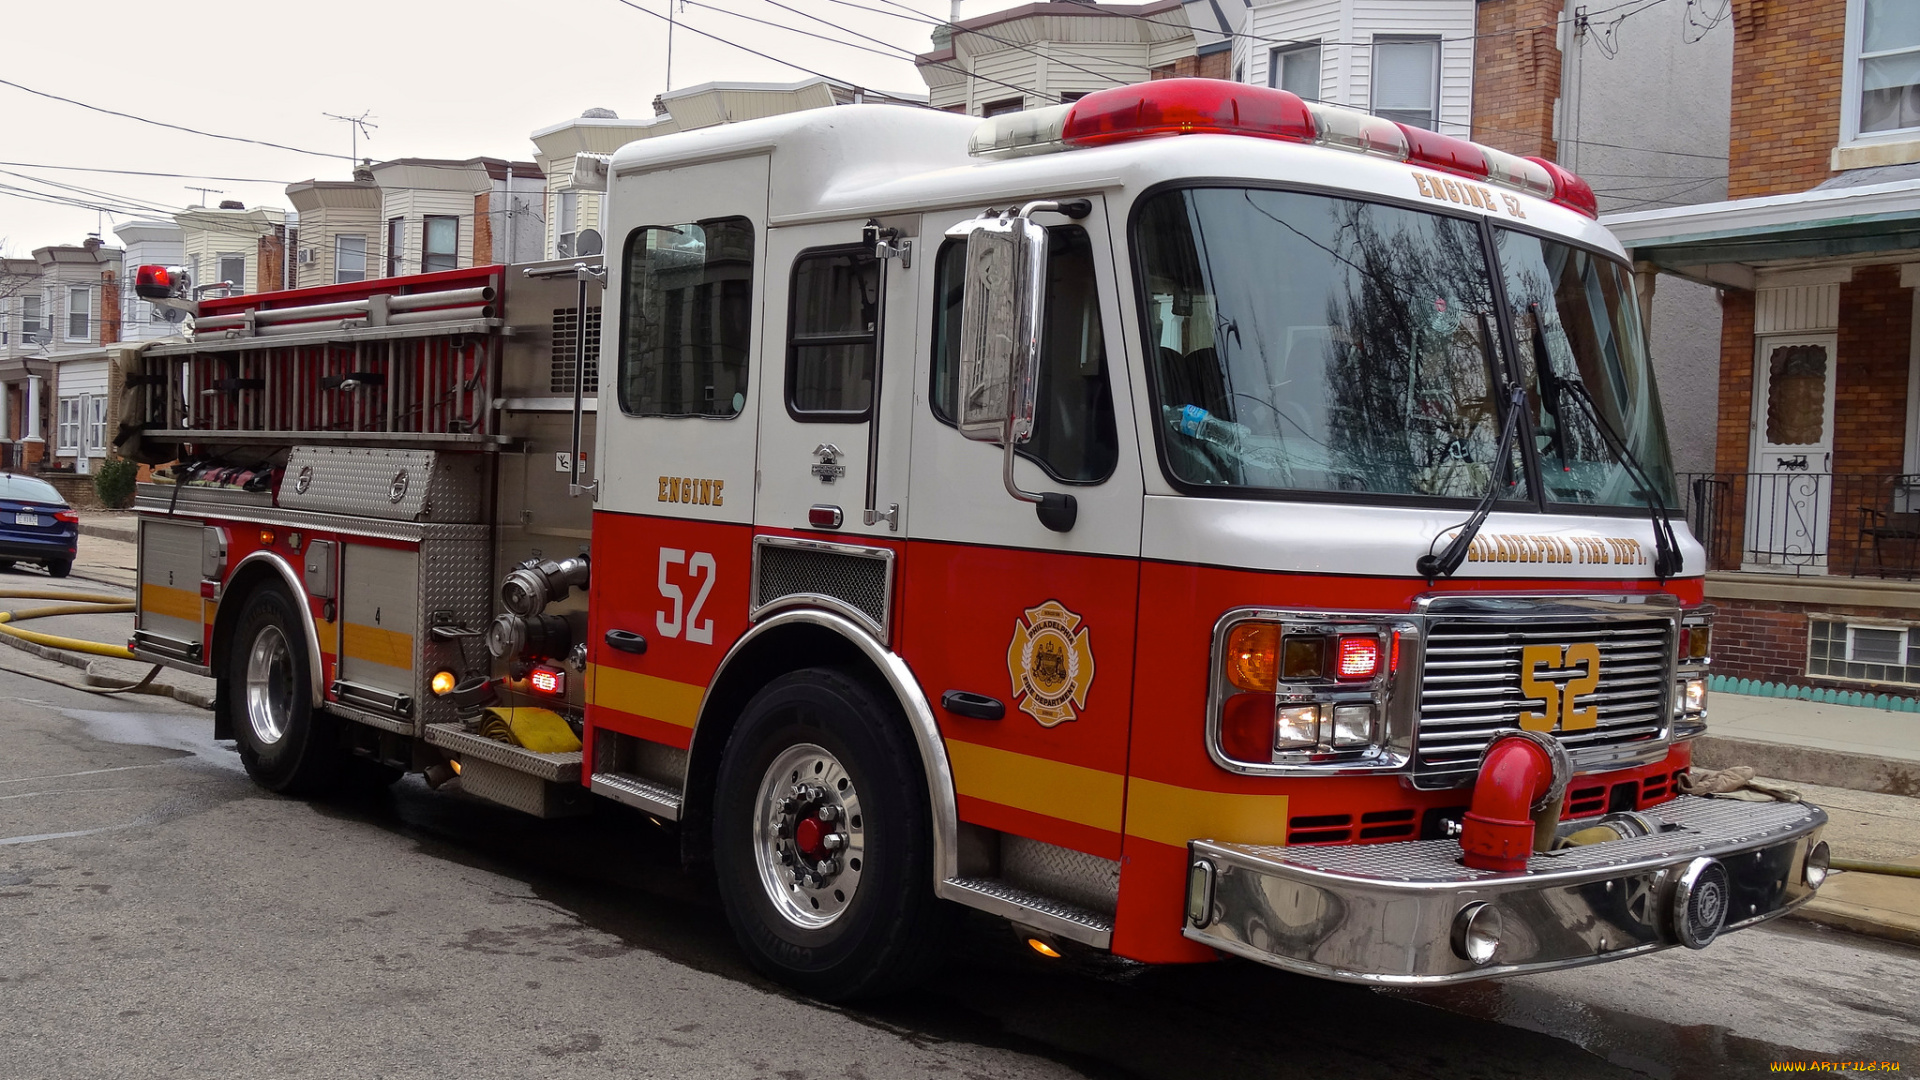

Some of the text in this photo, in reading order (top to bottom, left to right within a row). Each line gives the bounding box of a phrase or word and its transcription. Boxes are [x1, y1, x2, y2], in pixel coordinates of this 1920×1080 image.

[1411, 172, 1526, 219] ENGINE 52
[658, 476, 724, 506] ENGINE
[1449, 533, 1647, 566] HILADELPHIA FIRE DEPT.
[656, 546, 717, 645] 52
[375, 606, 381, 625] 4
[1028, 620, 1076, 645] PHILADELPHIA
[1023, 676, 1076, 707] FIRE DEPARTMENT
[1519, 642, 1600, 733] 52
